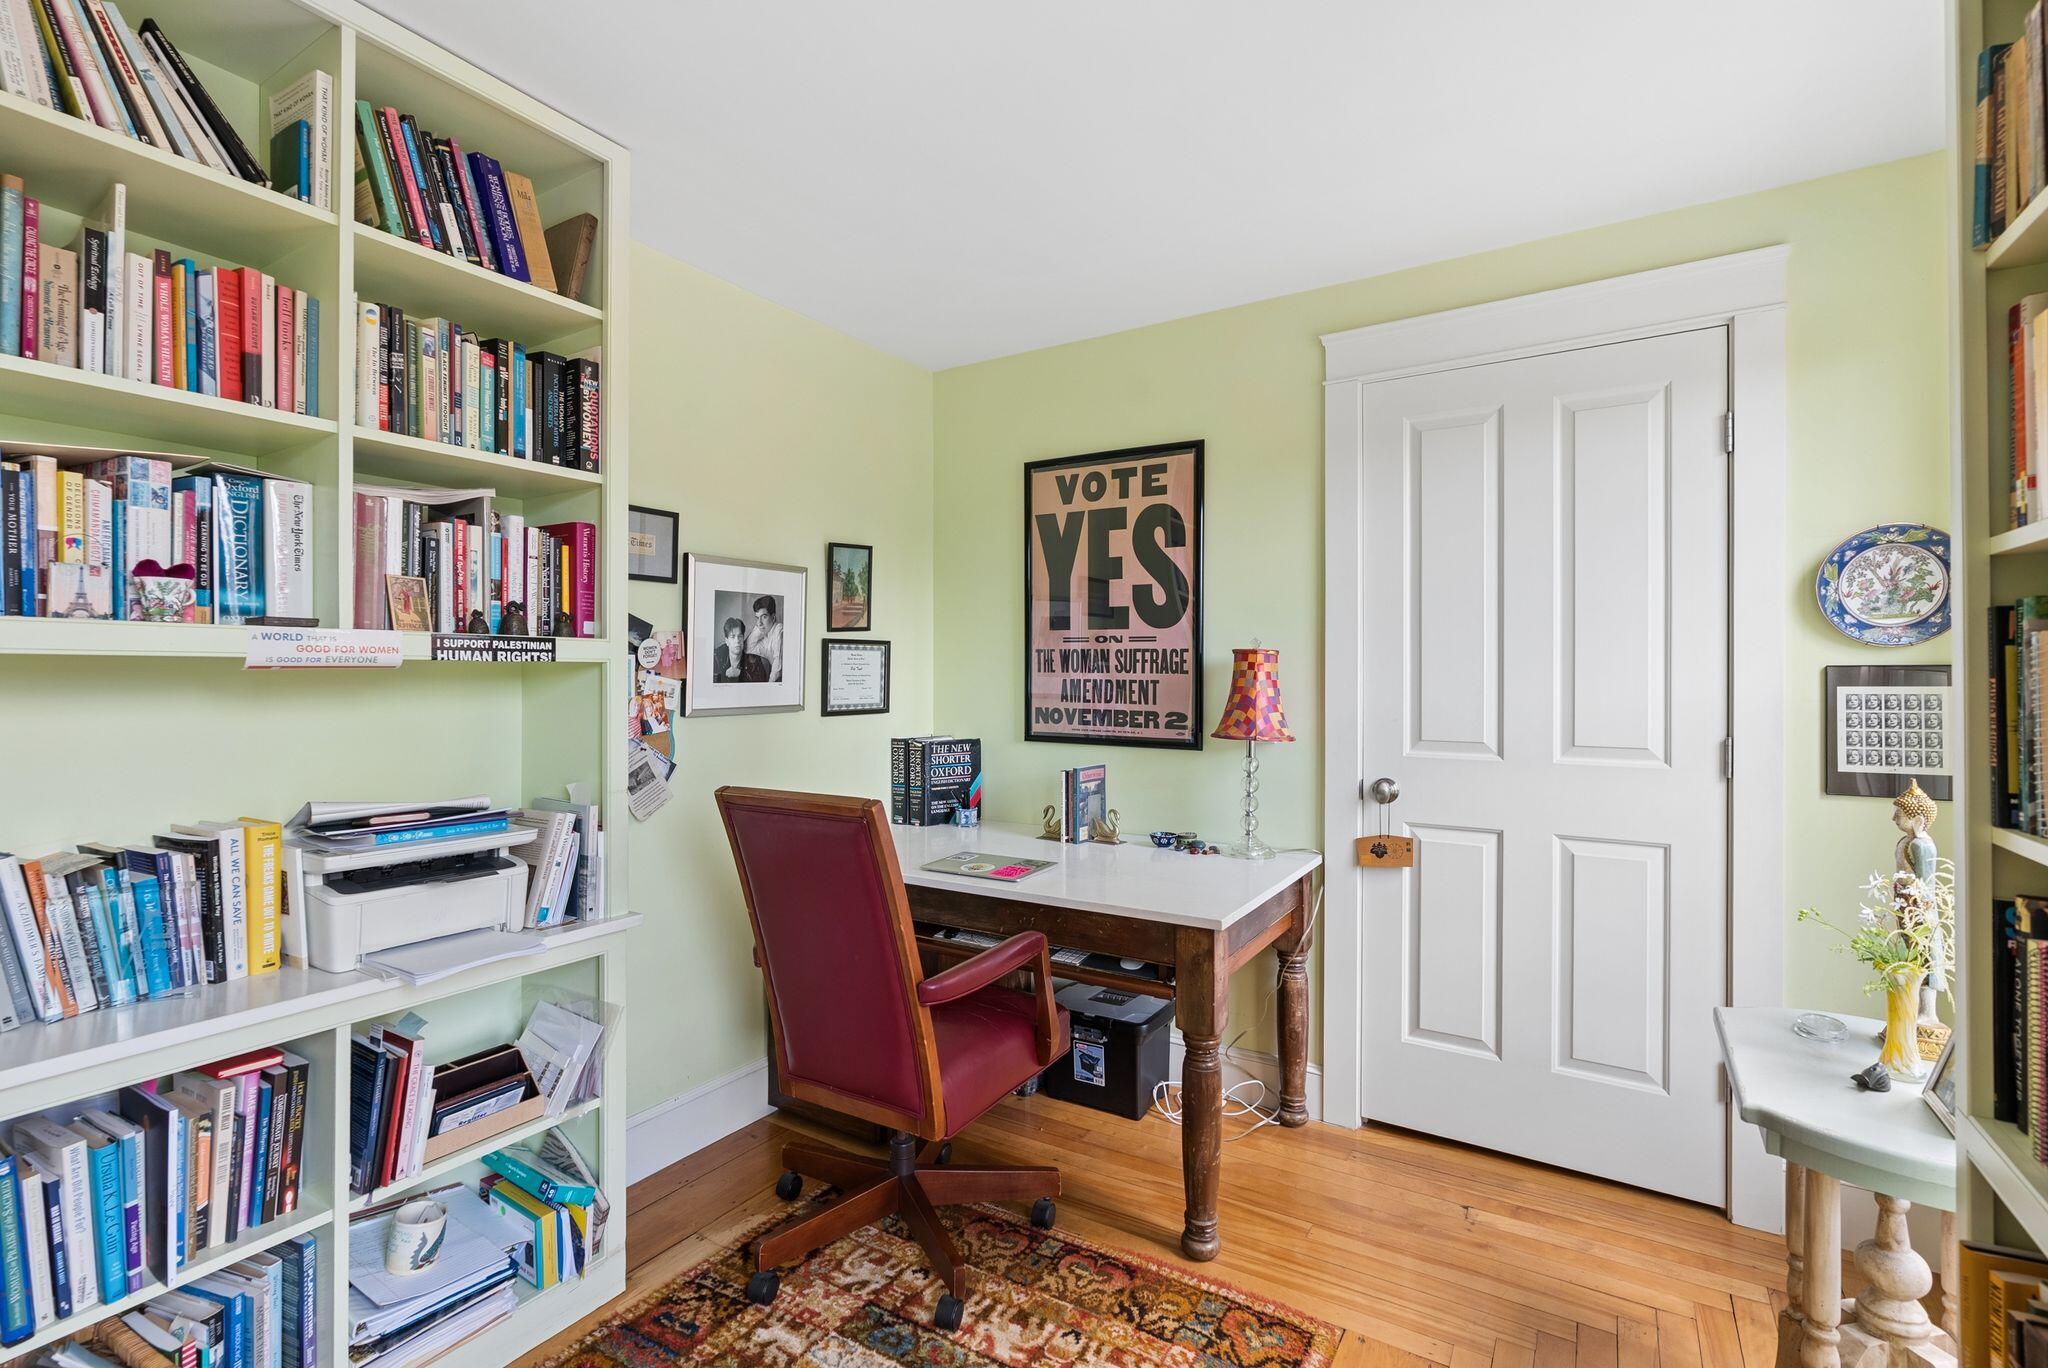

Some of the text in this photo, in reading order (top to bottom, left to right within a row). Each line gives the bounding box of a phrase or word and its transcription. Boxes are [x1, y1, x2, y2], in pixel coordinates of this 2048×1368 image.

[322, 125, 327, 134] OF
[1994, 167, 2006, 214] WRATH
[87, 238, 99, 290] Spiritual Ecology
[137, 280, 143, 290] OF
[44, 307, 54, 316] de
[282, 297, 291, 350] bell hooks
[44, 318, 54, 349] Beauvoir
[160, 283, 171, 381] WHOLE WOMAN HEALTH
[282, 355, 290, 366] all
[282, 367, 290, 389] about
[582, 390, 591, 447] BY WOMEN
[590, 391, 598, 459] QUOTATIONS
[66, 482, 72, 493] OF
[1054, 463, 1168, 505] VOTE
[8, 513, 17, 553] MOTHER
[90, 490, 100, 562] CHIMAMANDA NGOZI
[292, 495, 303, 572] The New York Times
[231, 500, 248, 600] DICTIONARY
[581, 528, 590, 583] Women's History
[630, 537, 653, 548] Times
[201, 554, 207, 562] TO
[1035, 503, 1190, 631] YES
[261, 632, 303, 642] WORLD
[296, 644, 399, 655] GOOD FOR WOMEN
[436, 638, 552, 650] I SUPPORT PALESTINIAN
[1094, 635, 1123, 644] ON
[265, 656, 378, 664] IS GOOD FOR EVERYONE
[437, 650, 552, 662] HUMAN RIGHTS!
[1035, 648, 1189, 675] THE WOMAN SUFFRAGE
[1060, 678, 1160, 706] AMENDMENT
[1034, 707, 1189, 730] NOVEMBER 2
[931, 743, 971, 753] THE NEW
[931, 755, 971, 765] SHORTER
[931, 766, 972, 777] OXFORD
[564, 820, 574, 836] Good
[230, 838, 242, 925] ALL WE CAN SAVE
[264, 844, 275, 954] THE FREAKS CAME OUT TO WRITE
[2014, 958, 2023, 1102] ALONE TOGETHER
[402, 1063, 420, 1129] THE GRACE IN AGING
[244, 1086, 256, 1154] MAKE TROUBLE
[68, 1145, 82, 1167] What
[70, 1167, 82, 1179] Are
[71, 1193, 86, 1217] People
[98, 1151, 121, 1255] Ursula K. Le Guin
[0, 1177, 21, 1303] WOMEN PRAISE SACRED
[127, 1220, 137, 1254] Facing Age
[306, 1270, 314, 1338] PLAYWRITING
[1991, 1283, 2002, 1356] NAOMI KLEIN
